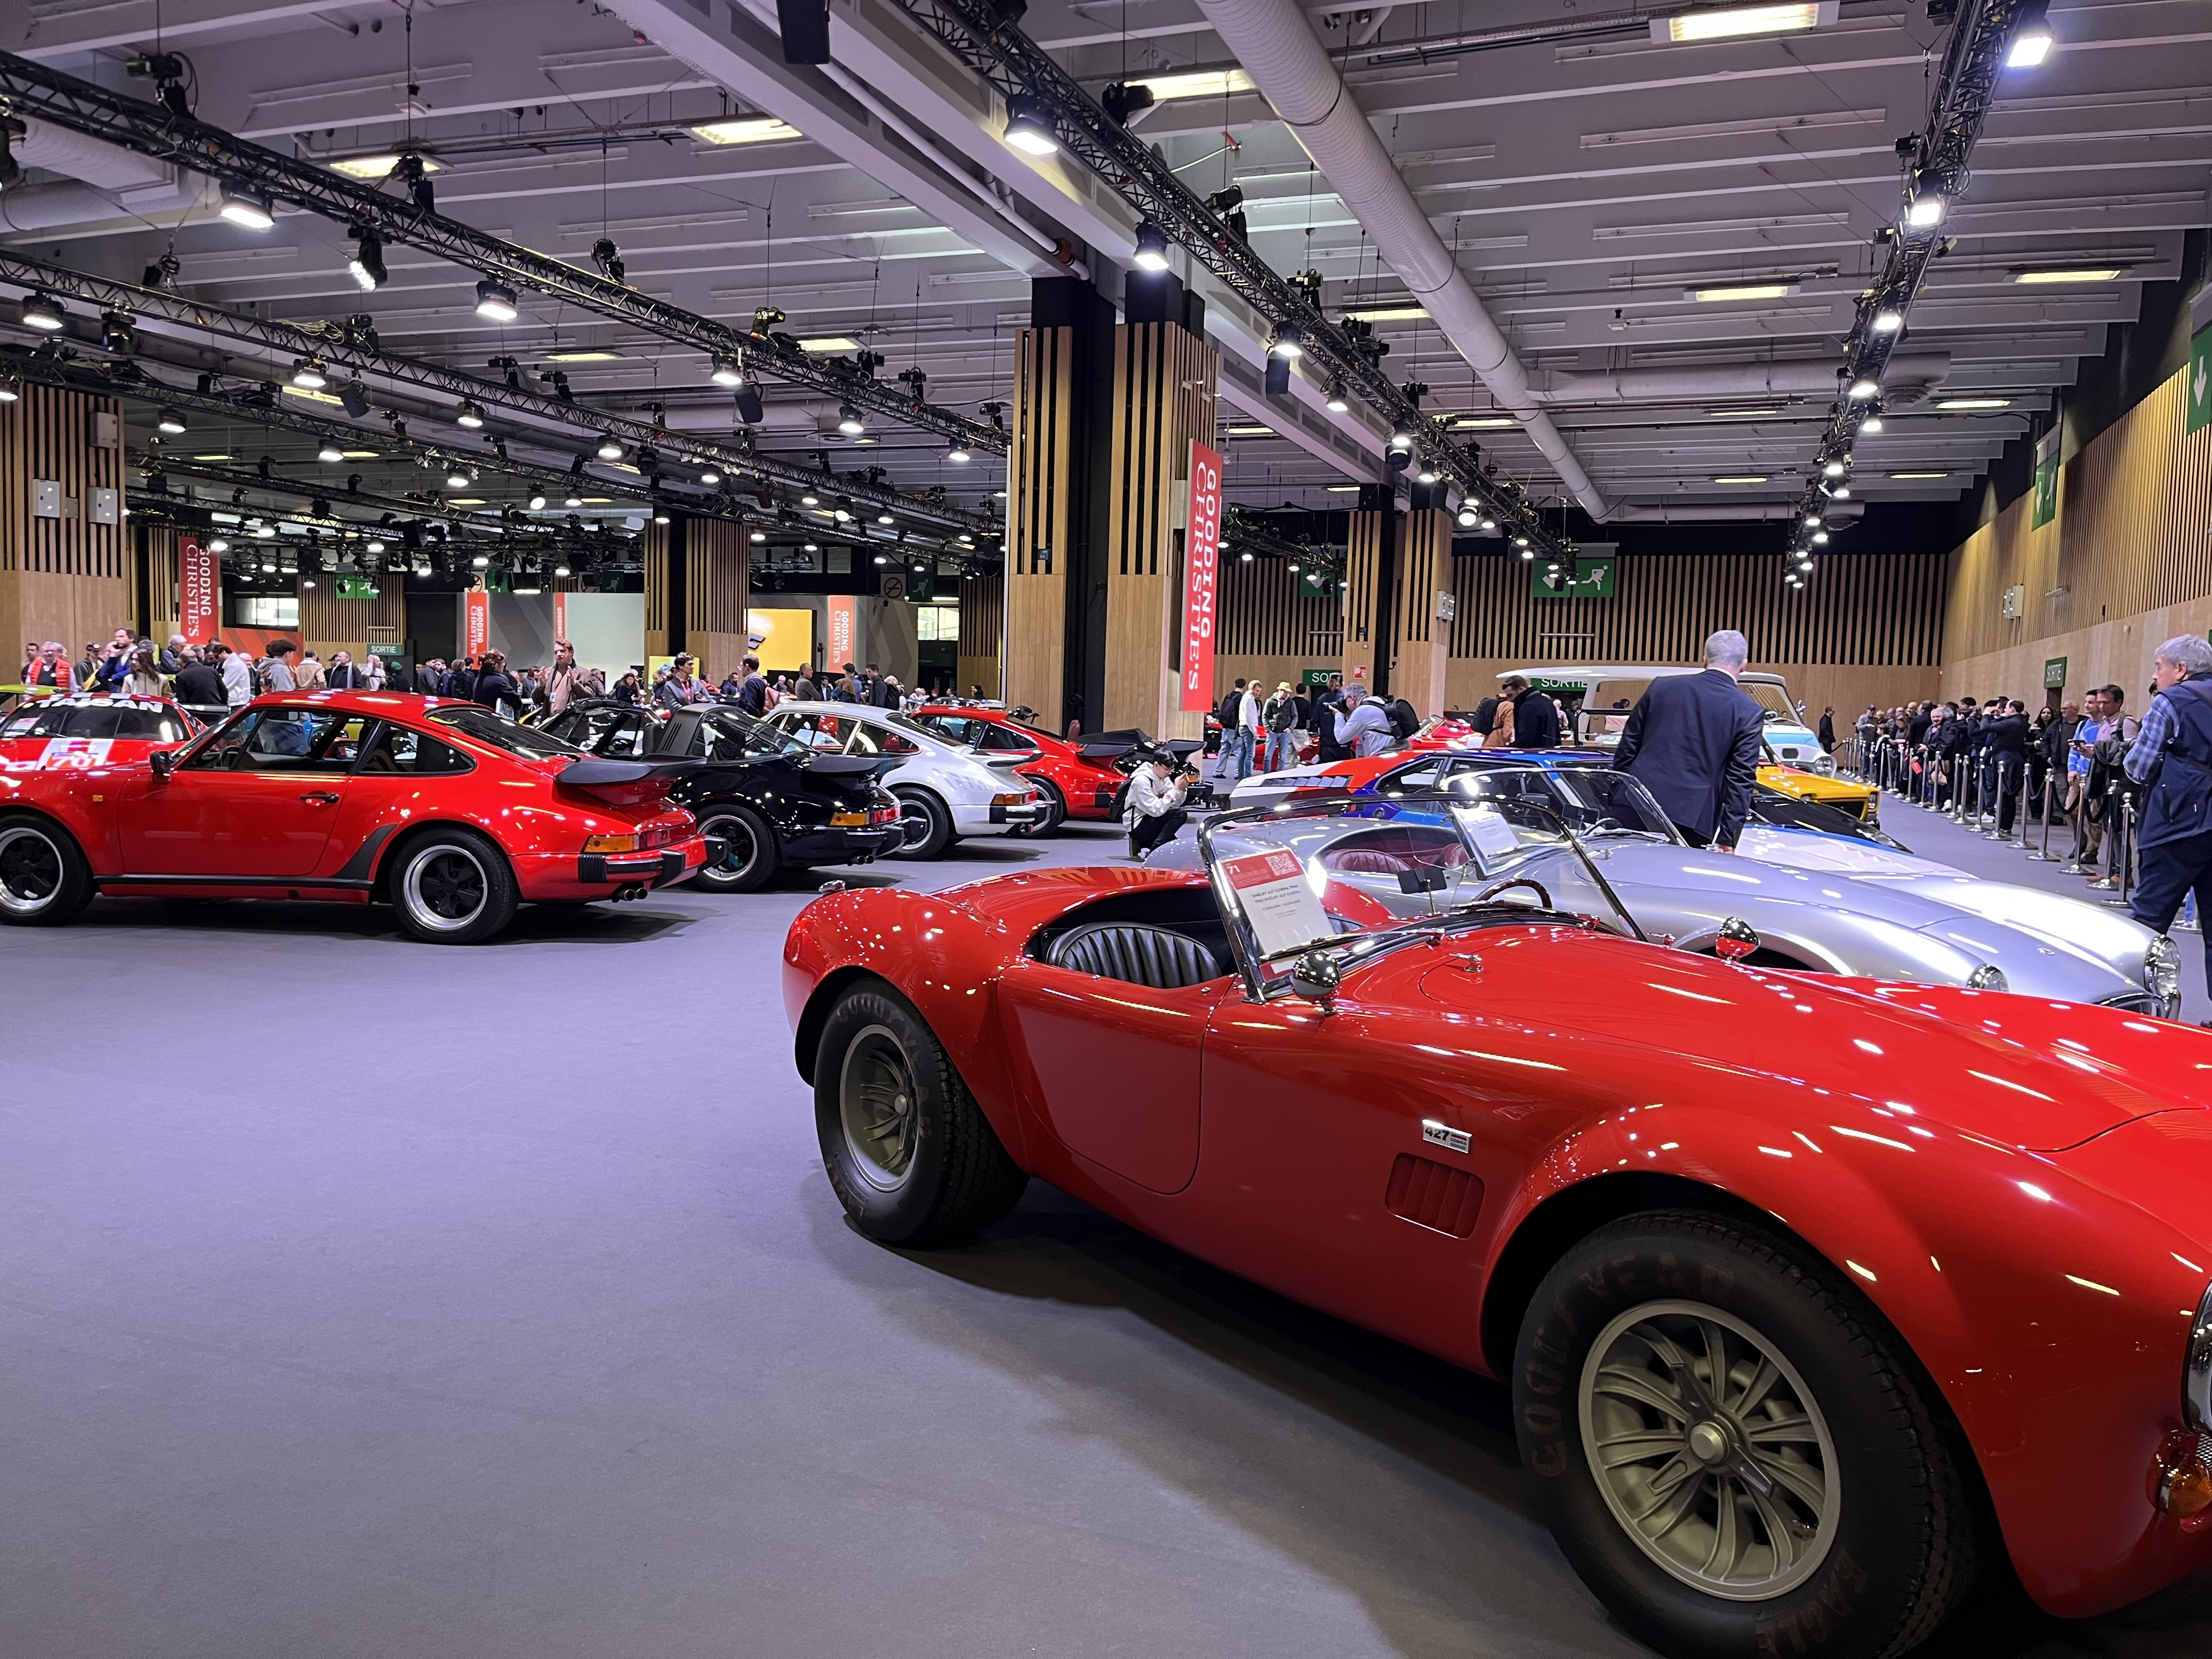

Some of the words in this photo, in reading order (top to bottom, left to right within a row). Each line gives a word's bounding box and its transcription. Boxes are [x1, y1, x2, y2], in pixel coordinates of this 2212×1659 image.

[1200, 469, 1216, 638] GOODING
[1188, 461, 1207, 691] CHRISTIE'S
[187, 544, 199, 637] CHRISTIE'S
[371, 645, 396, 653] SORTIE
[2046, 663, 2062, 682] SORTIE
[1226, 865, 1240, 874] 71
[1425, 1126, 1449, 1141] 427
